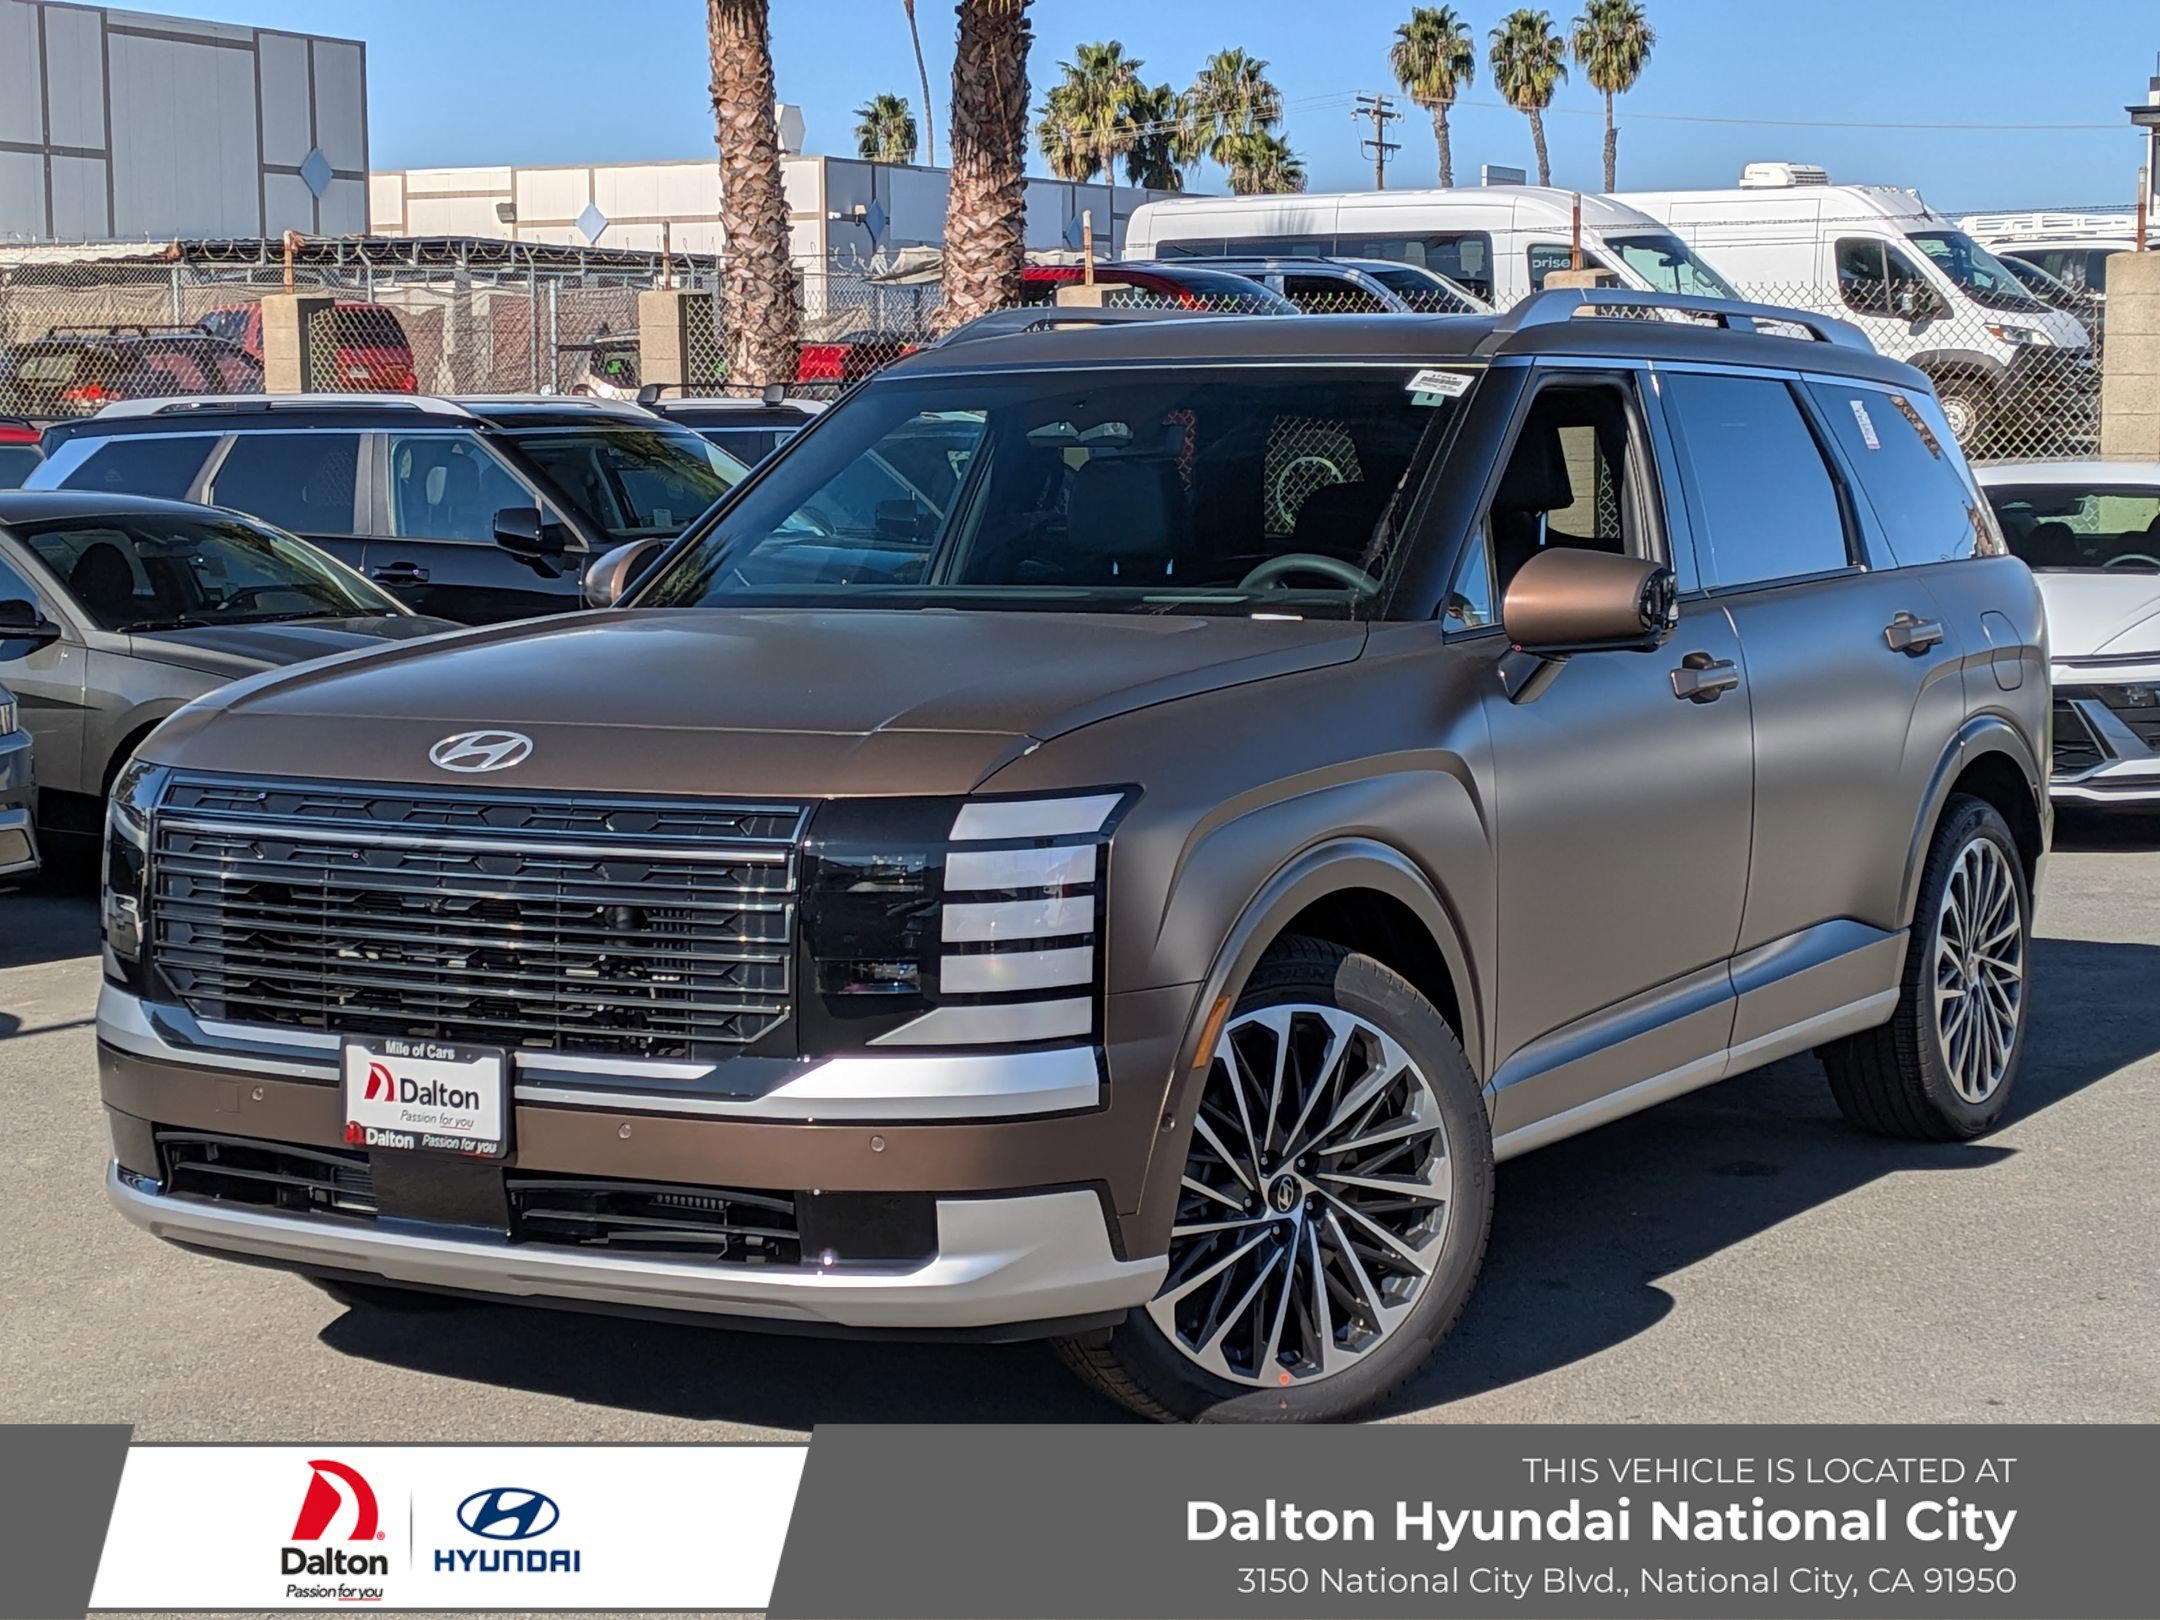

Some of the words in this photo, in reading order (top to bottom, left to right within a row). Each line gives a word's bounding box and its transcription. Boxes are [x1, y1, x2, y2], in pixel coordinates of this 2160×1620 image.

[385, 1041, 409, 1055] Mile
[412, 1043, 425, 1056] of
[427, 1045, 455, 1059] Cars
[400, 1078, 479, 1110] Dalton
[400, 1110, 438, 1123] Passion
[439, 1113, 453, 1124] for
[455, 1118, 474, 1128] you
[366, 1128, 414, 1149] Dalton
[421, 1134, 459, 1148] Passion
[461, 1138, 475, 1151] for
[475, 1141, 497, 1154] you
